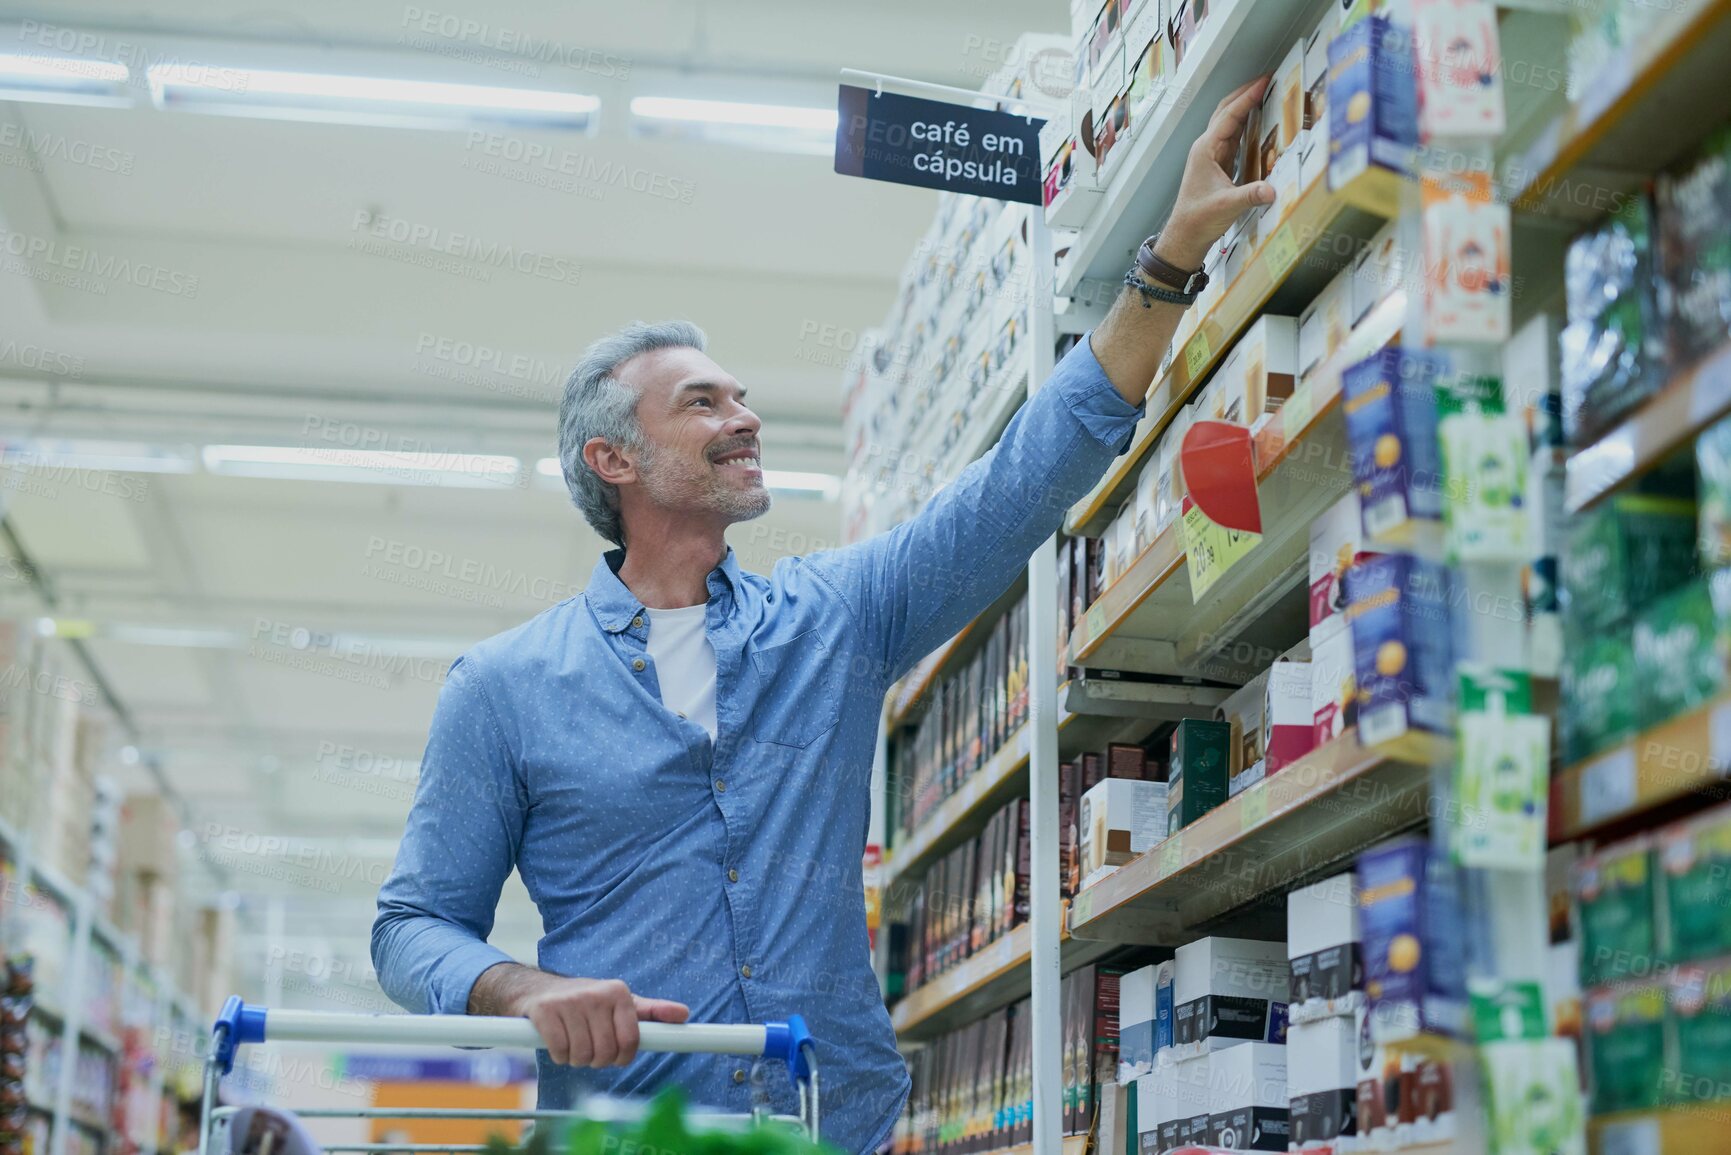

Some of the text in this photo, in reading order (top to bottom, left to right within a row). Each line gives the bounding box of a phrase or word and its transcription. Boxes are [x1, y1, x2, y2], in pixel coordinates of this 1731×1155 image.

[911, 121, 1024, 155] café em
[913, 150, 1018, 185] cápsula
